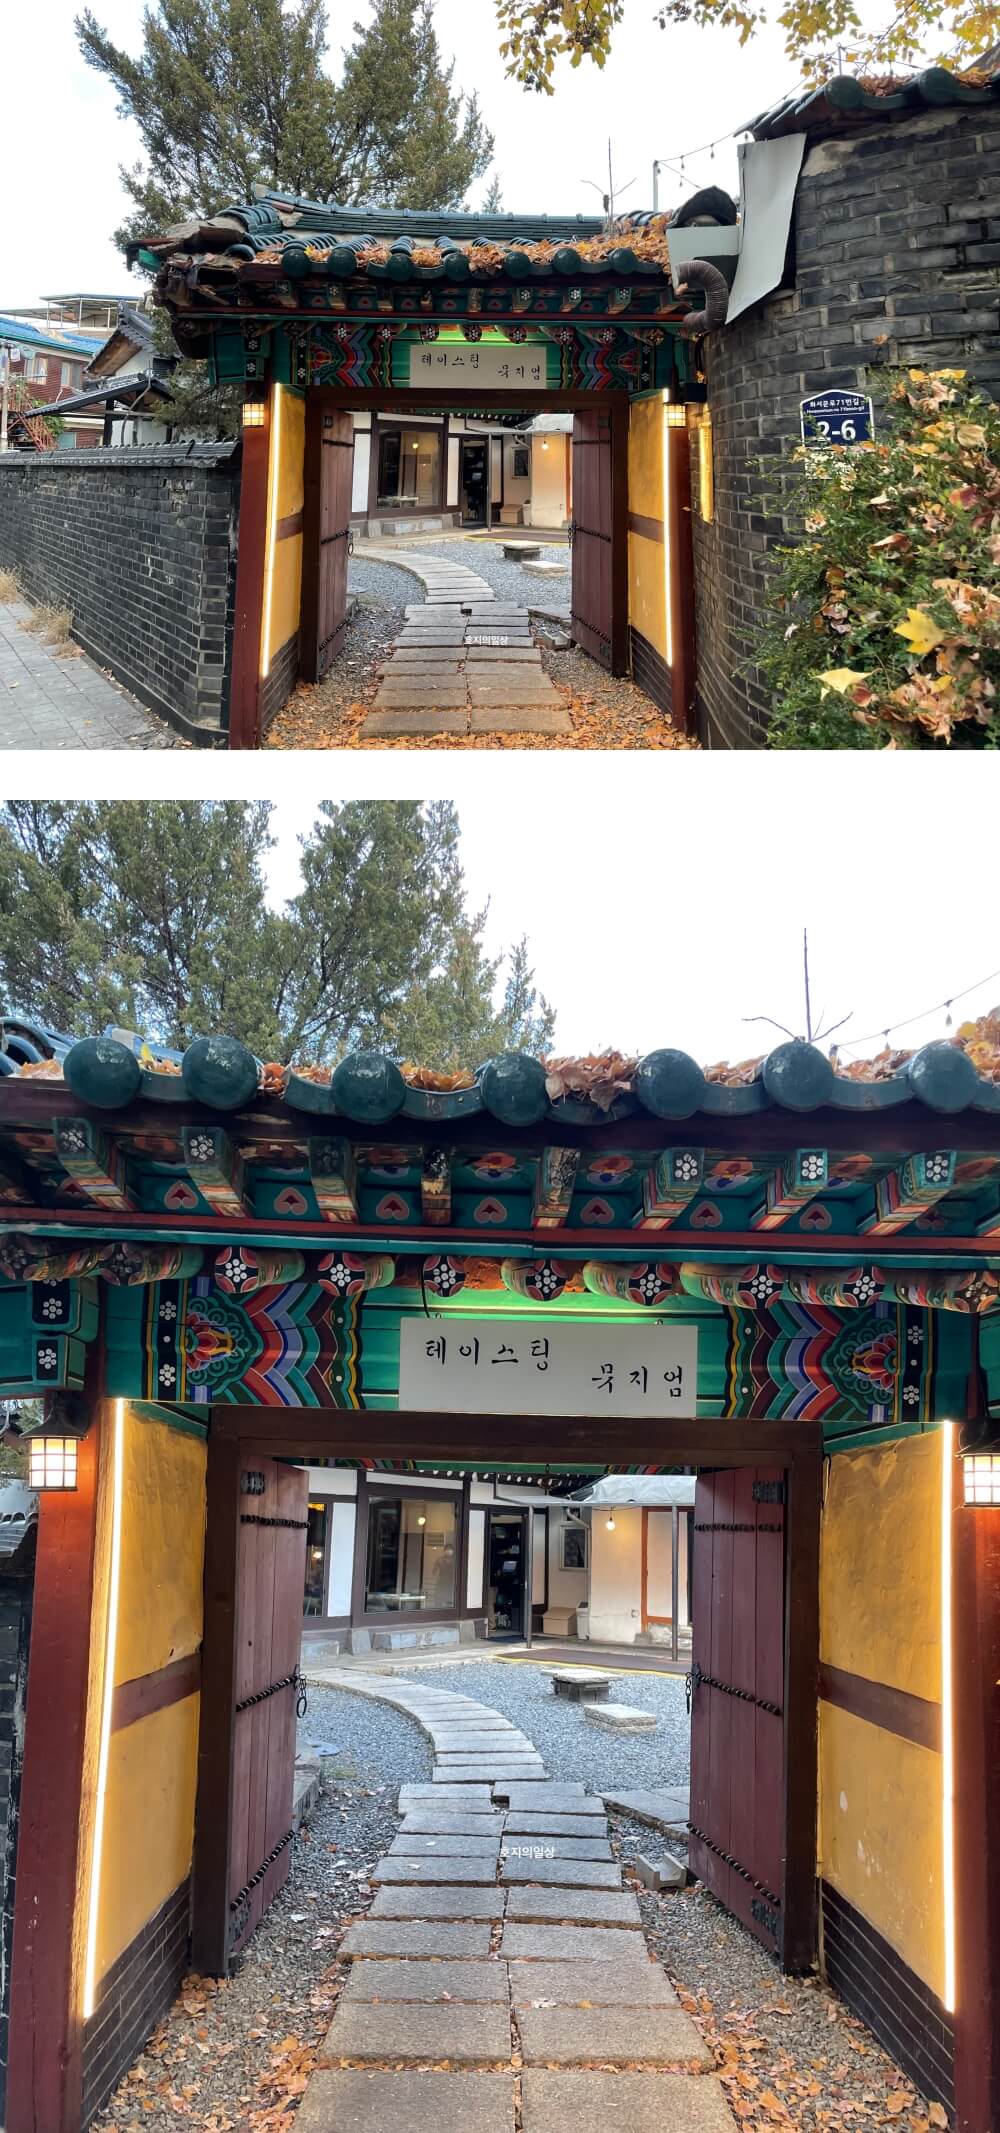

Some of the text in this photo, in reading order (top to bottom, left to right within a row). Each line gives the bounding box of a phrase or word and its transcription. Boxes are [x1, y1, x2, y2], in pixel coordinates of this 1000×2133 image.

[420, 353, 480, 369] 테이스팅
[497, 364, 541, 381] 뮤지엄
[816, 419, 856, 441] 2-6
[425, 1336, 550, 1371] 테이스팅
[591, 1363, 683, 1398] 뮤지엄
